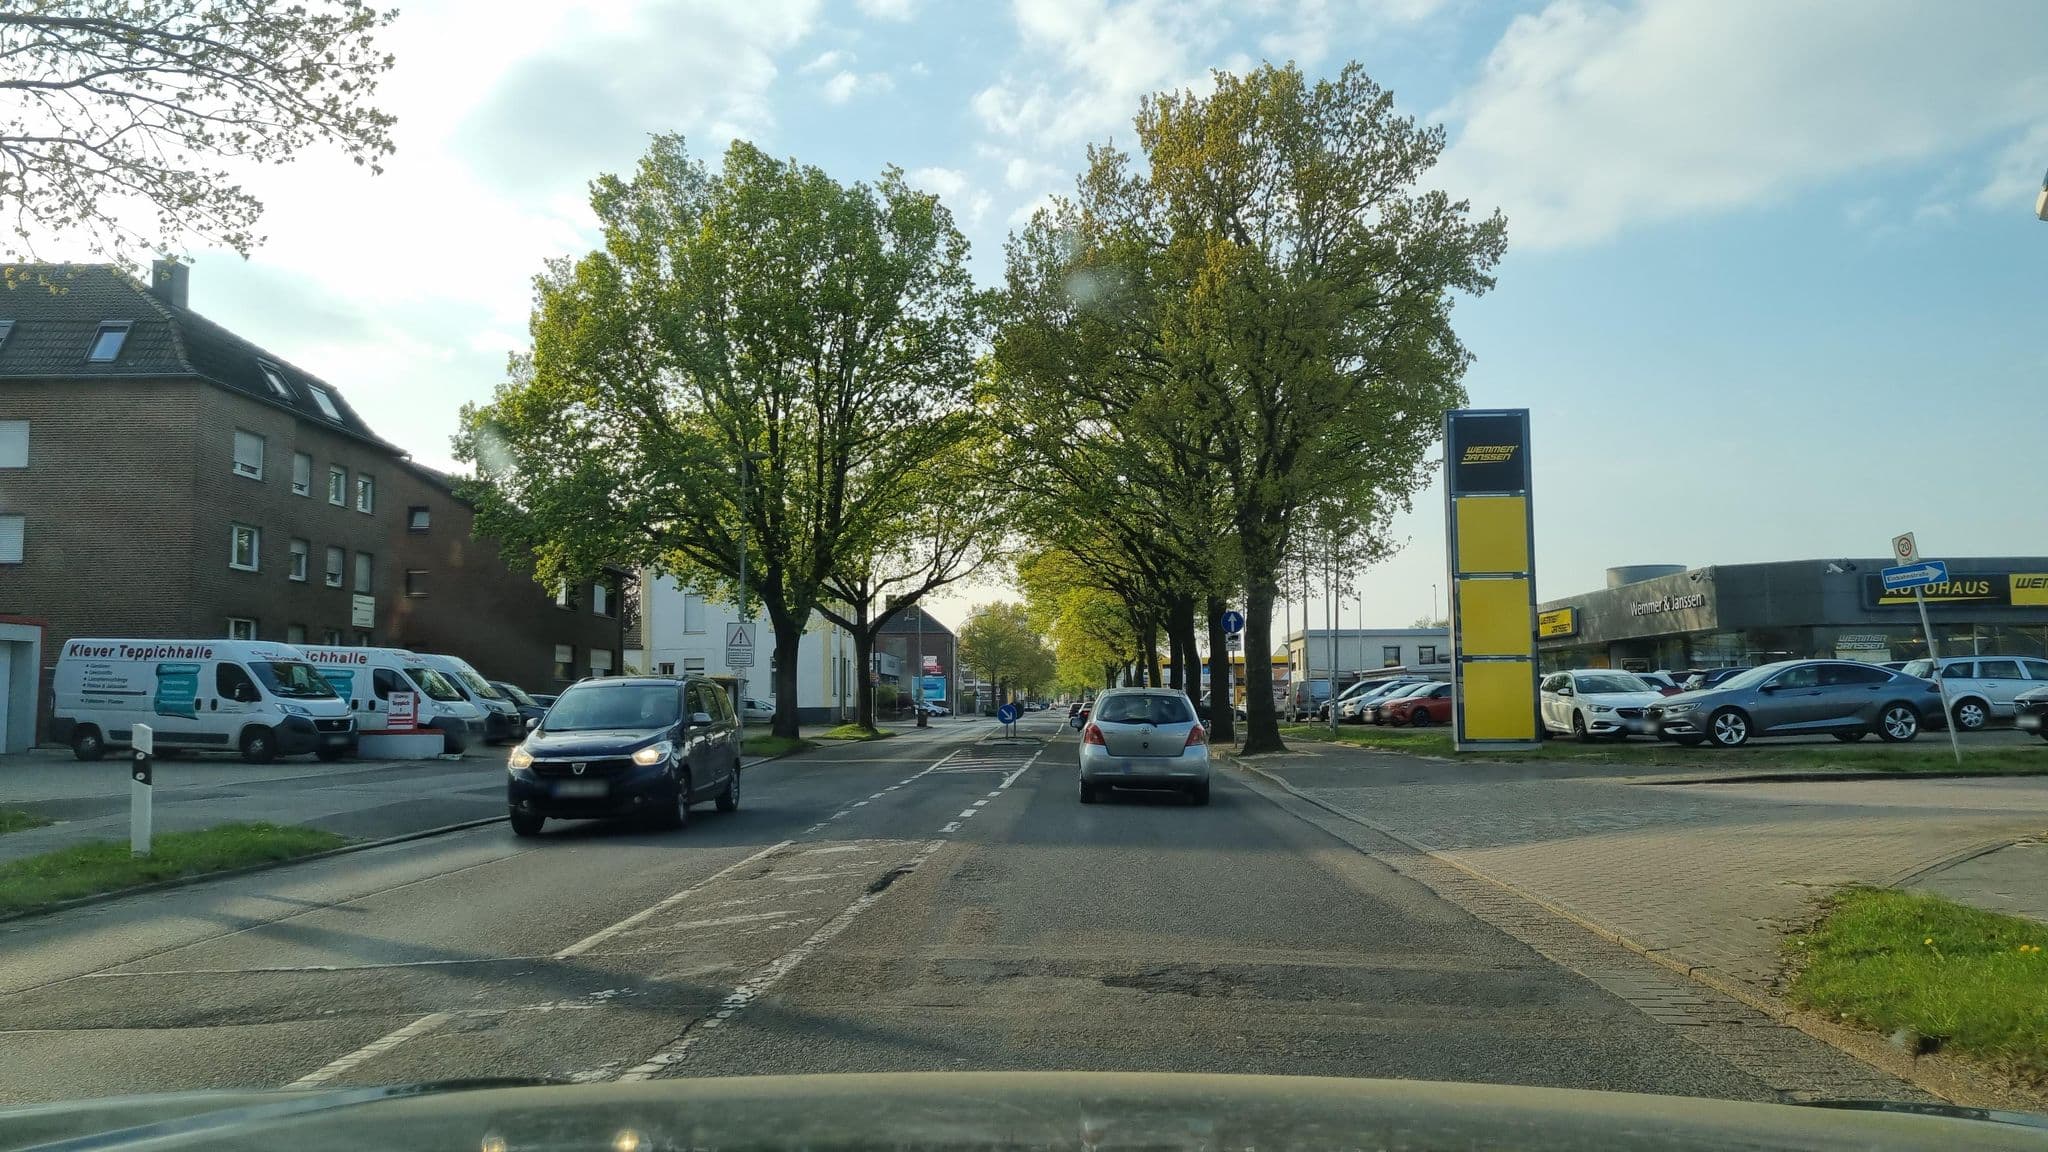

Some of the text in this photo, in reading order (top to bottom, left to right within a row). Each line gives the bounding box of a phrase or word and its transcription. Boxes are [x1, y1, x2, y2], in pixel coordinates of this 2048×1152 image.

[1466, 445, 1517, 454] WEMMER
[1463, 453, 1512, 461] JANSSEN
[1885, 581, 1990, 595] AUOHAUS
[1631, 593, 1704, 617] Wemmer & Janssen
[1839, 634, 1888, 642] WEMMER
[69, 644, 213, 661] Klever Teppichhalle
